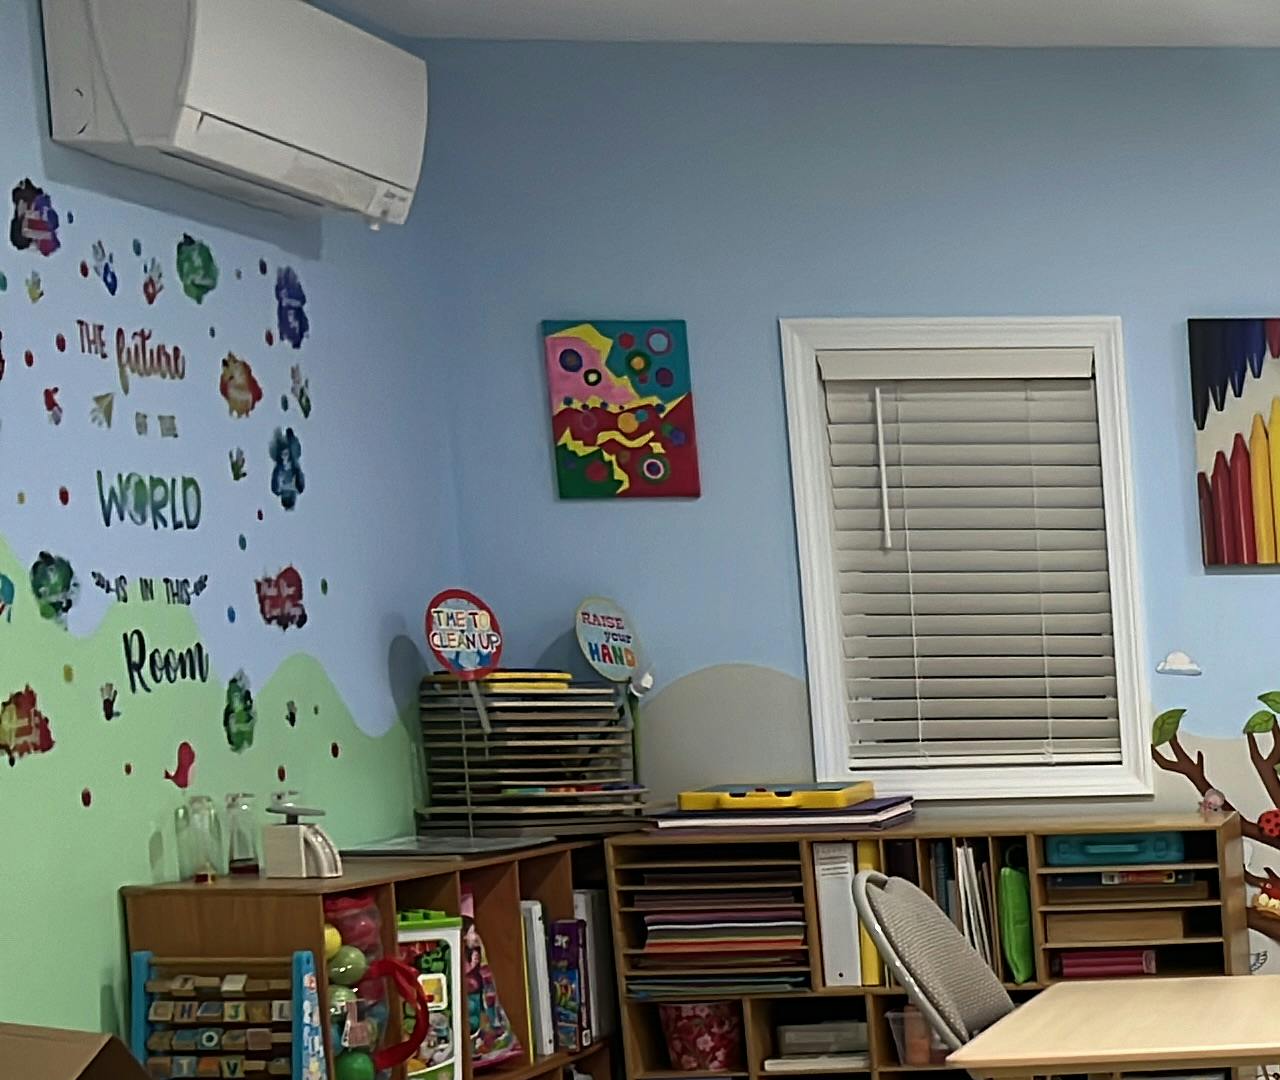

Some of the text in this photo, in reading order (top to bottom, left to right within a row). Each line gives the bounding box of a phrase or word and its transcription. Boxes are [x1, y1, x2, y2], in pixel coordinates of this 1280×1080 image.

[77, 320, 185, 396] THE future
[97, 470, 201, 530] WORLD
[115, 575, 190, 605] IS IN THIS
[468, 612, 489, 628] TO
[581, 612, 624, 629] RAISE
[432, 632, 499, 650] CLEAN UP
[122, 629, 209, 694] Room
[588, 642, 636, 667] HAND
[228, 1005, 240, 1019] J
[179, 1059, 239, 1077] T V
